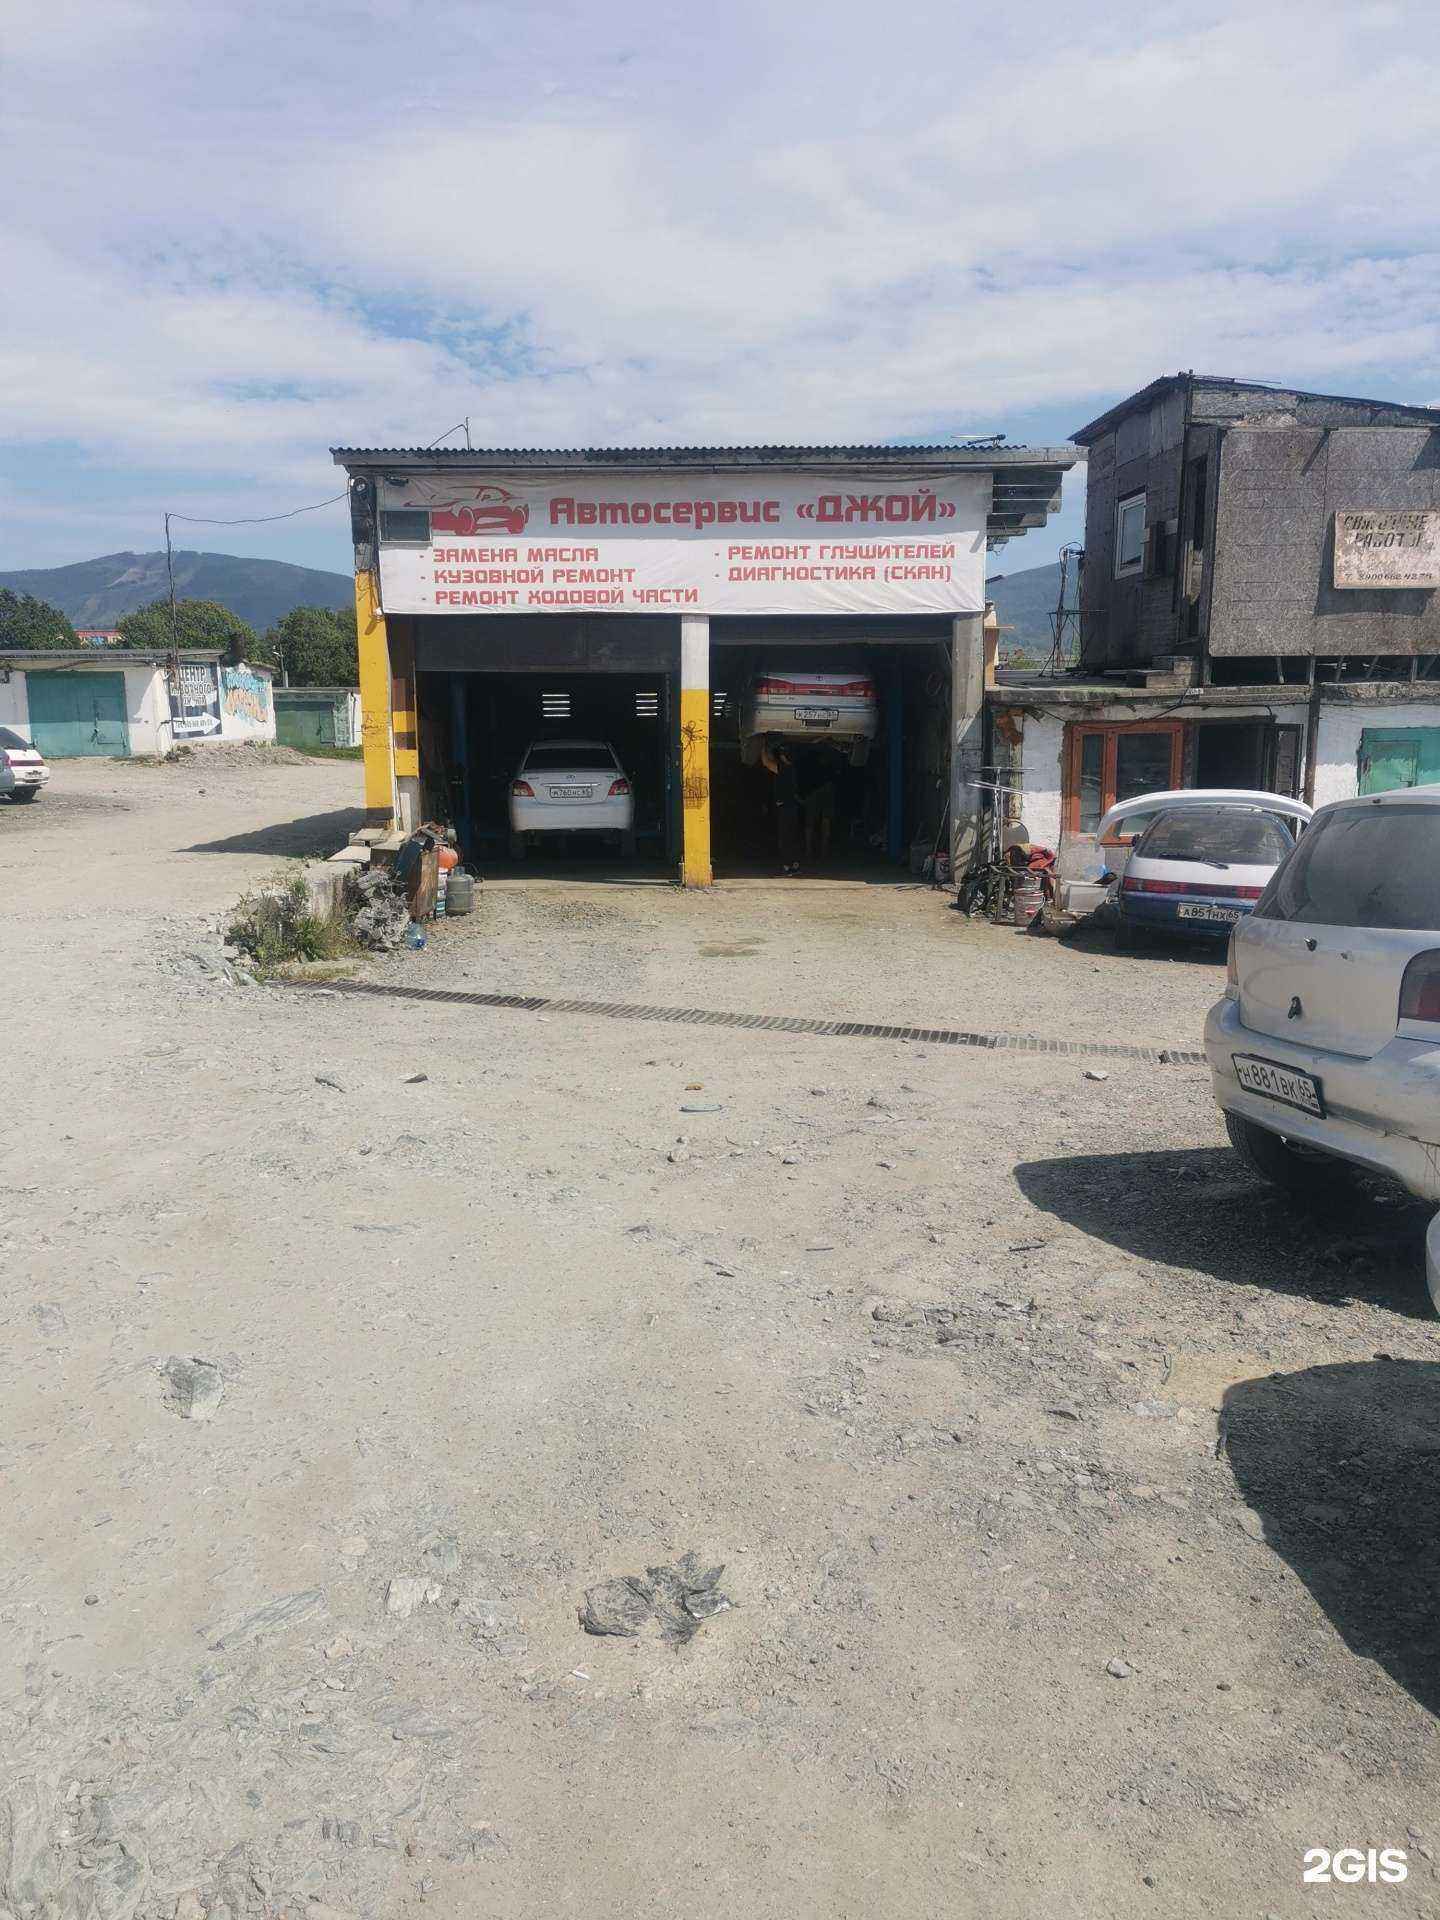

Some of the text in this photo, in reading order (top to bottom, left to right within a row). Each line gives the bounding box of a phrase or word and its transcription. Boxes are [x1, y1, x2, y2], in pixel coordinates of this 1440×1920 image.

[549, 489, 957, 529] Автосервис «ДЖОЙ»
[433, 547, 599, 563] ЗАМЕНА МАСЛА
[728, 536, 956, 560] РЕМОНТ ГЛУШИТЕЛЕЙ
[434, 567, 636, 584] КУЗОВНОЙ РЕМОНТ
[728, 564, 952, 583] ДИАГНОСТИКА (СКАН)
[435, 586, 698, 605] РЕМОНТ ХОДОВОЙ ЧАСТИ
